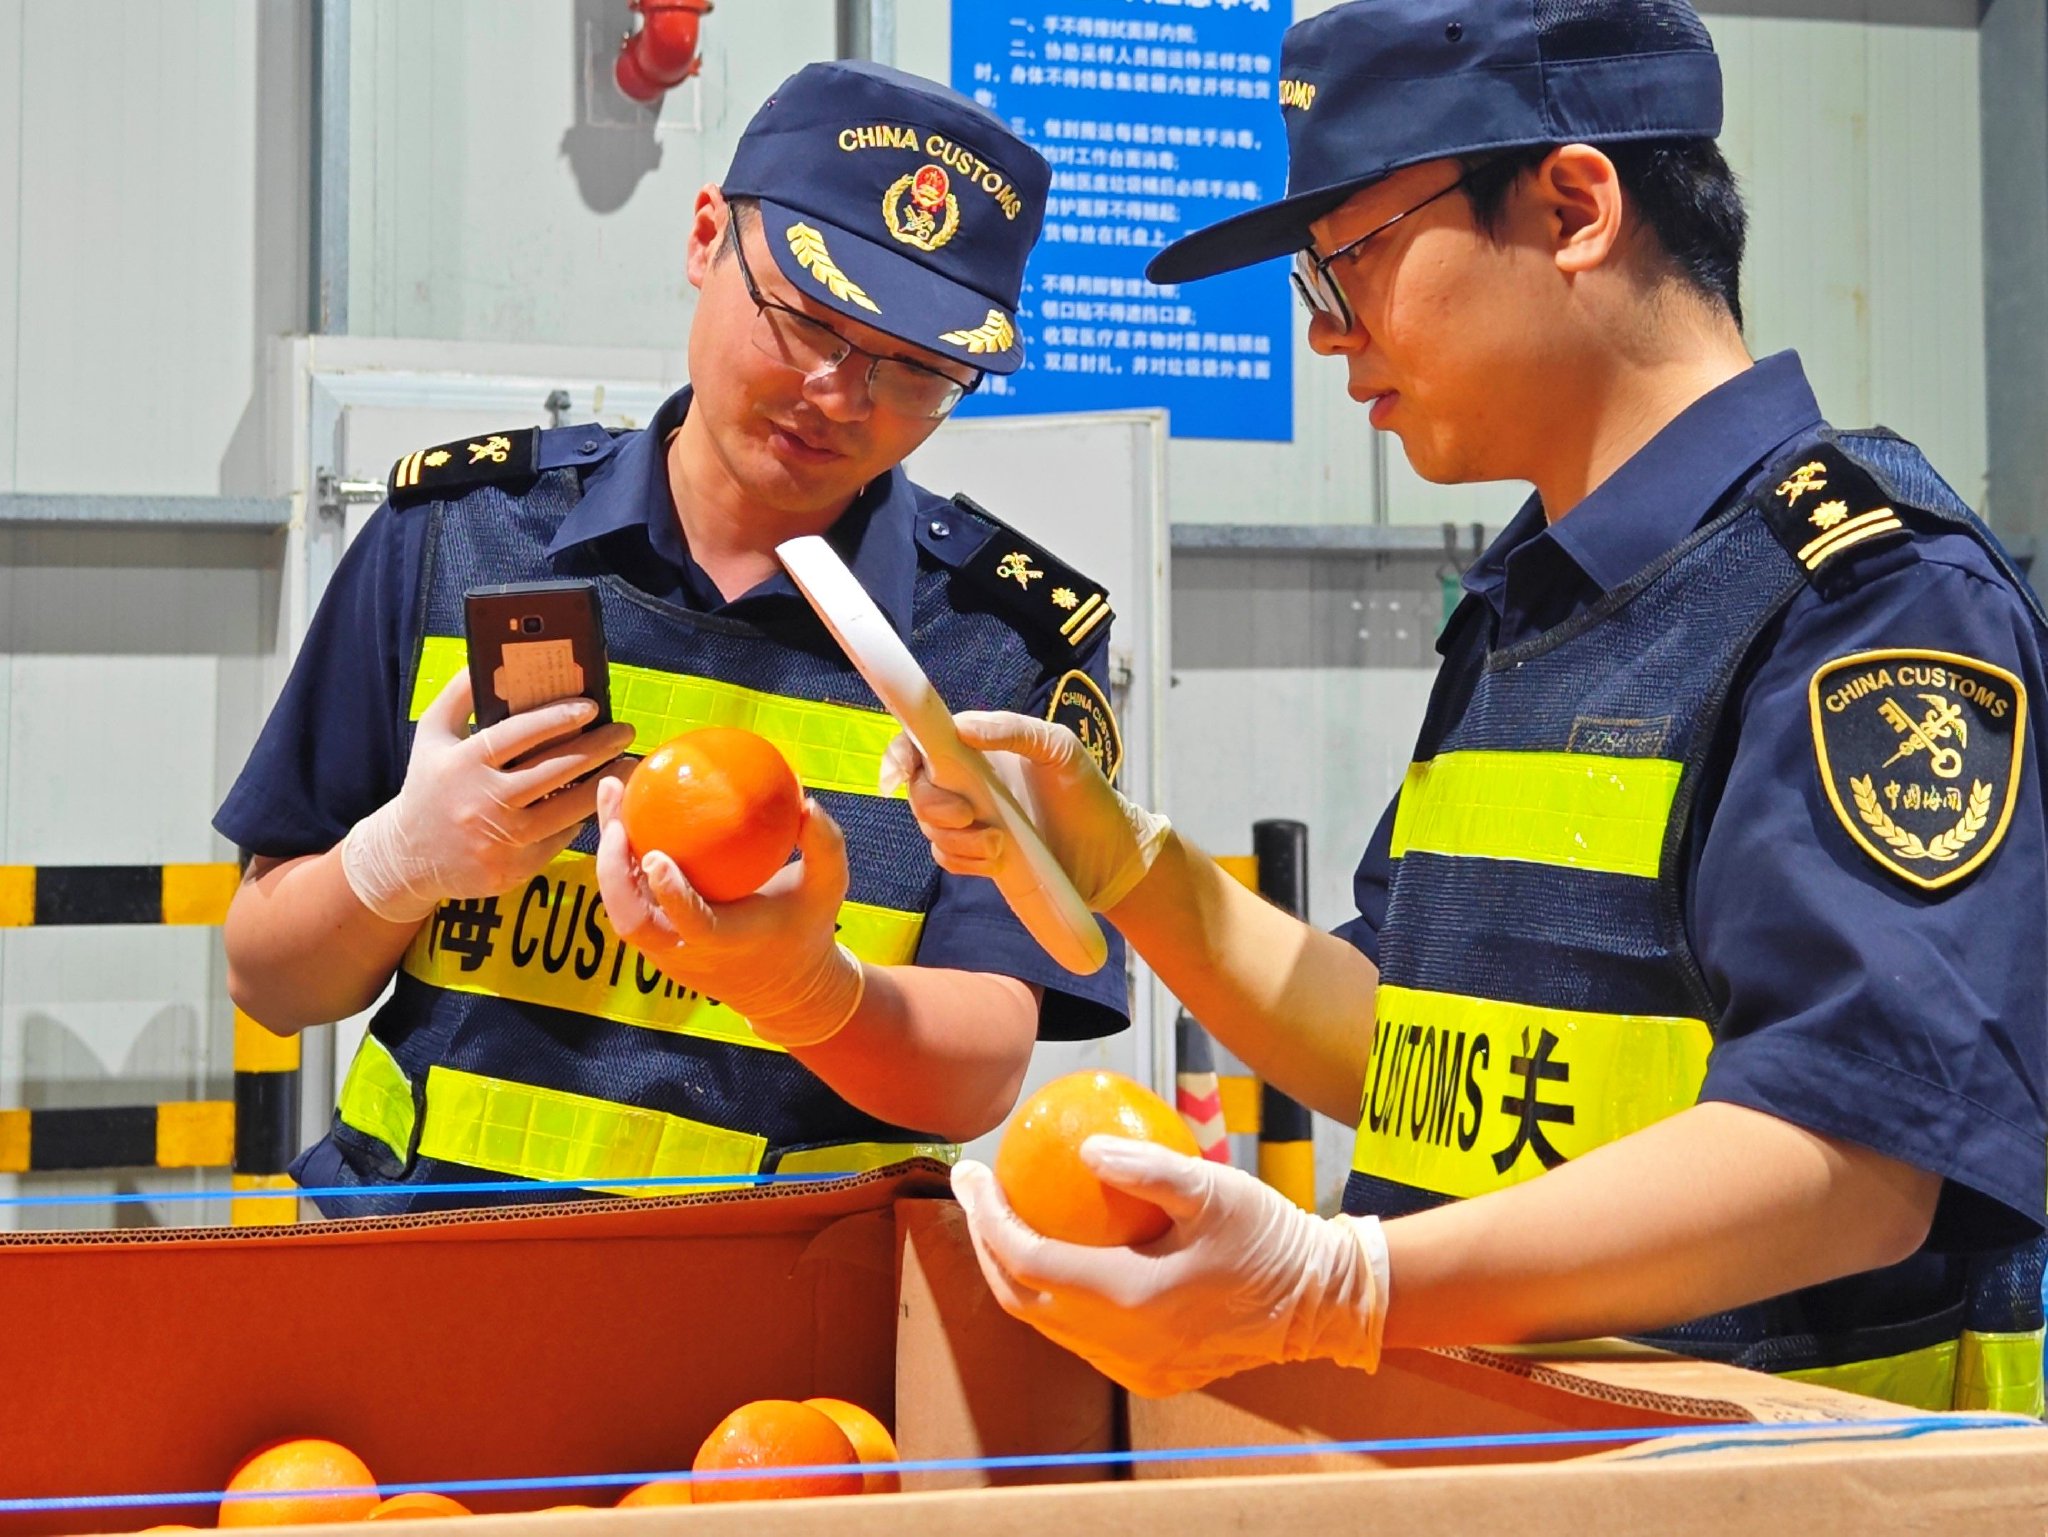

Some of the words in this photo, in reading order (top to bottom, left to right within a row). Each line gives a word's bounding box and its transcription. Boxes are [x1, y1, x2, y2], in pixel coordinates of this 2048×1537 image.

[838, 125, 919, 152] CHINA
[925, 135, 1022, 221] CUSTOMS
[1061, 692, 1092, 713] CHINA
[1825, 668, 1894, 713] CHINA
[1897, 667, 2008, 718] CUSTOMS
[1491, 1026, 1574, 1176] 关
